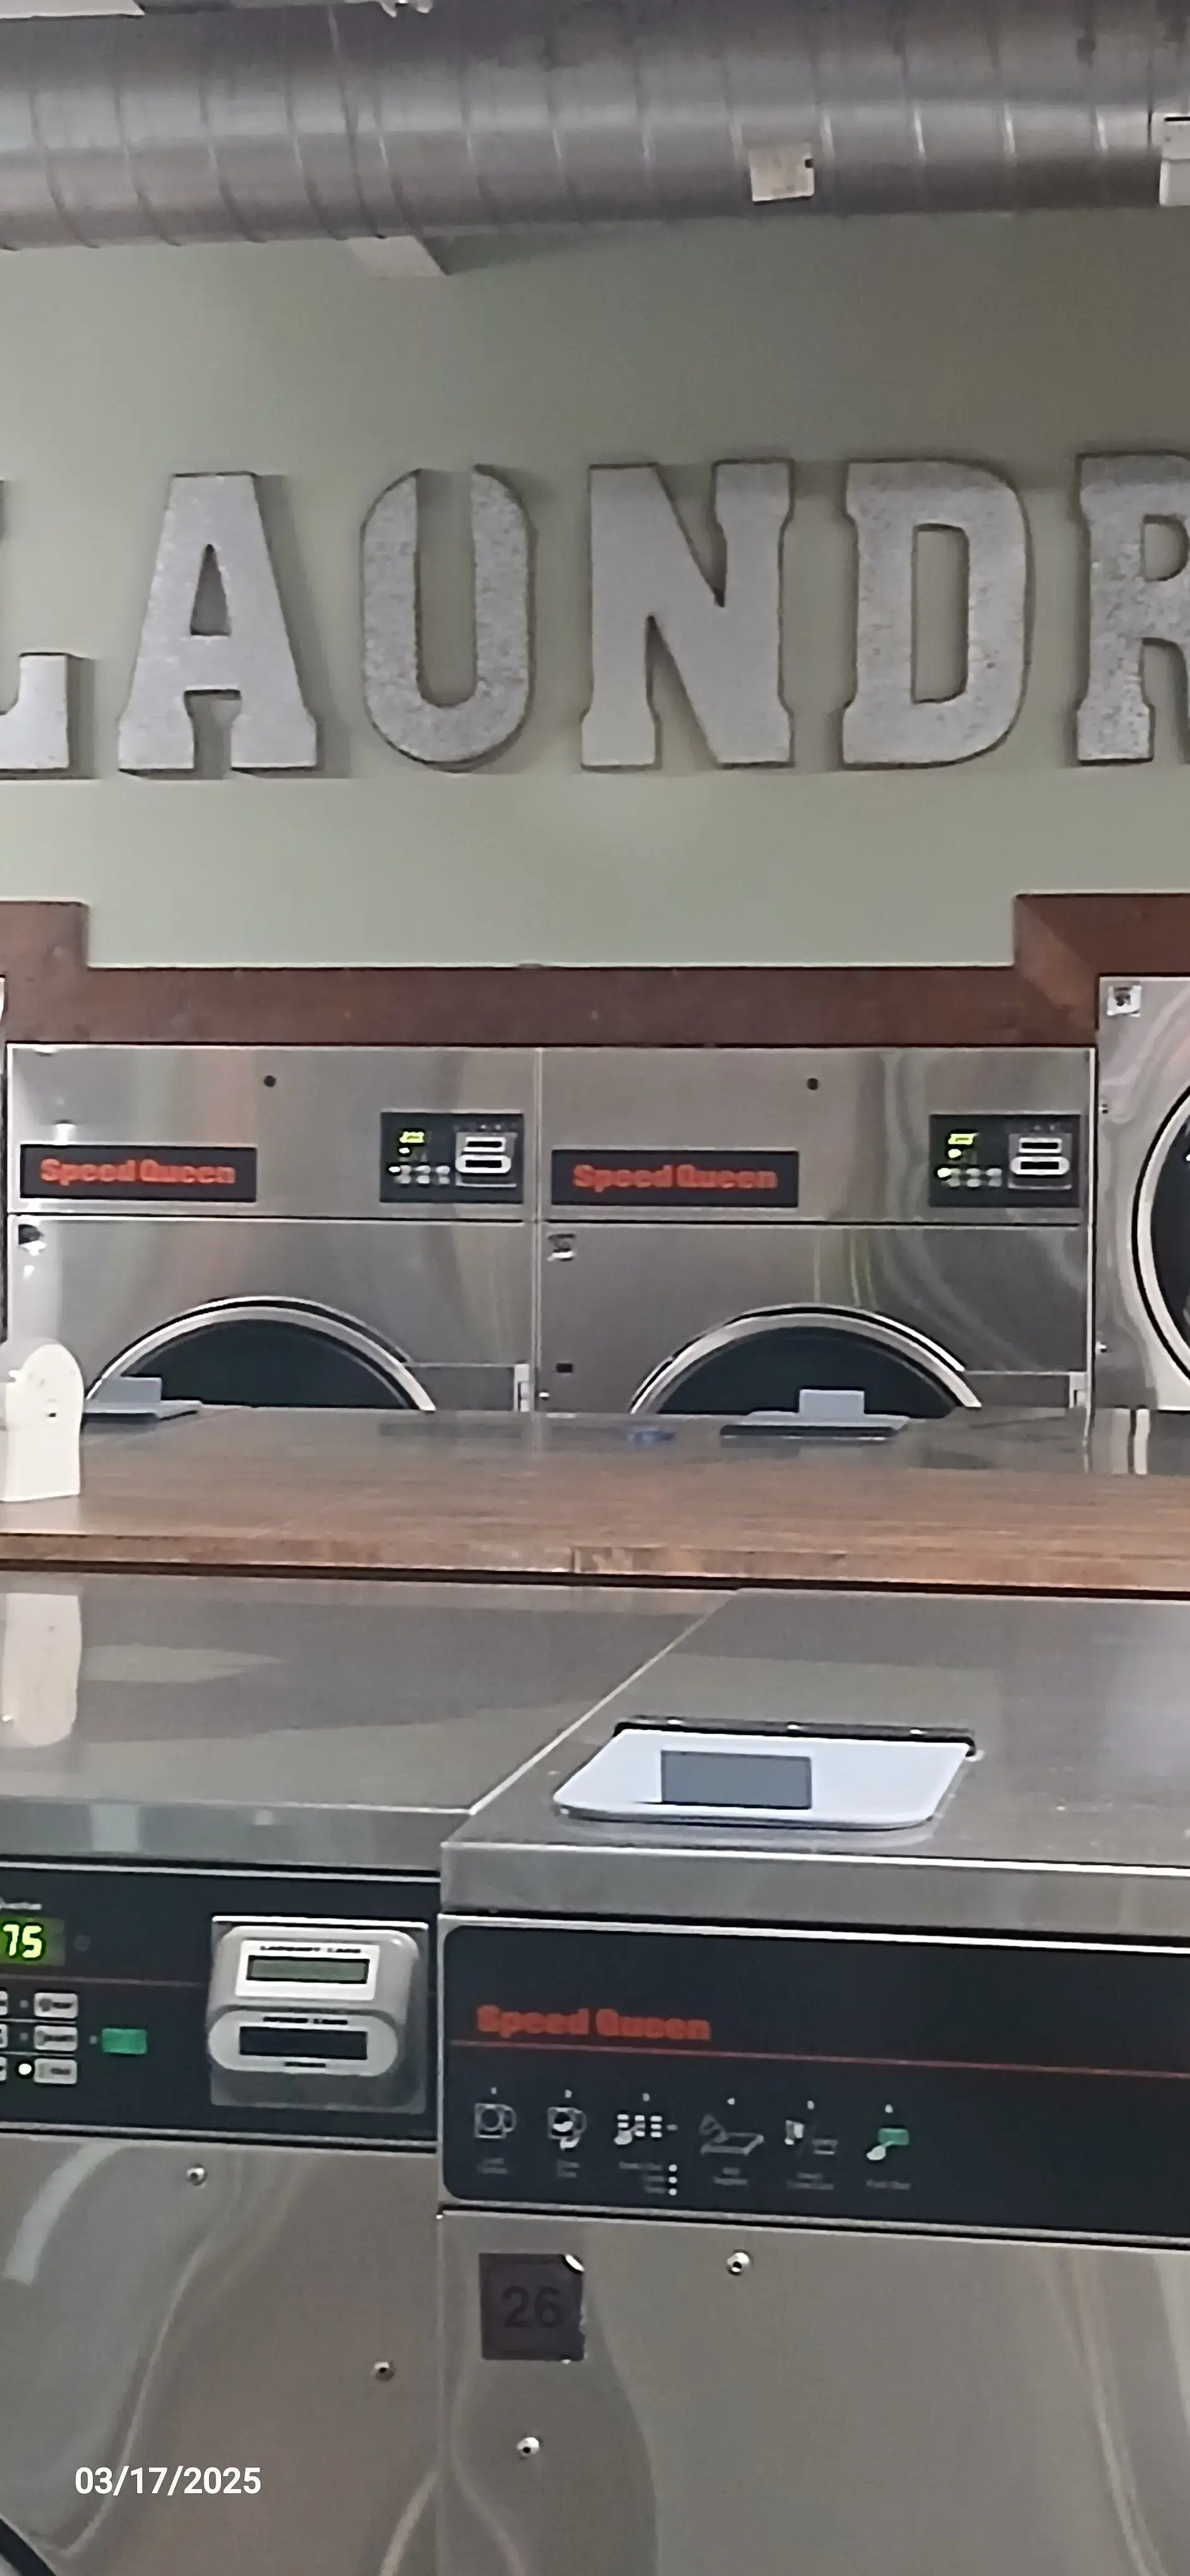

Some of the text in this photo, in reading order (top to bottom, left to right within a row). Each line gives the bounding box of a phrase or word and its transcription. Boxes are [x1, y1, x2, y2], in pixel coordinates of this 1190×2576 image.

[40, 1158, 236, 1186] Speed Queen
[573, 1164, 778, 1193] Speed Queen
[477, 2005, 711, 2041] Speed Queen
[502, 2286, 563, 2329] 26
